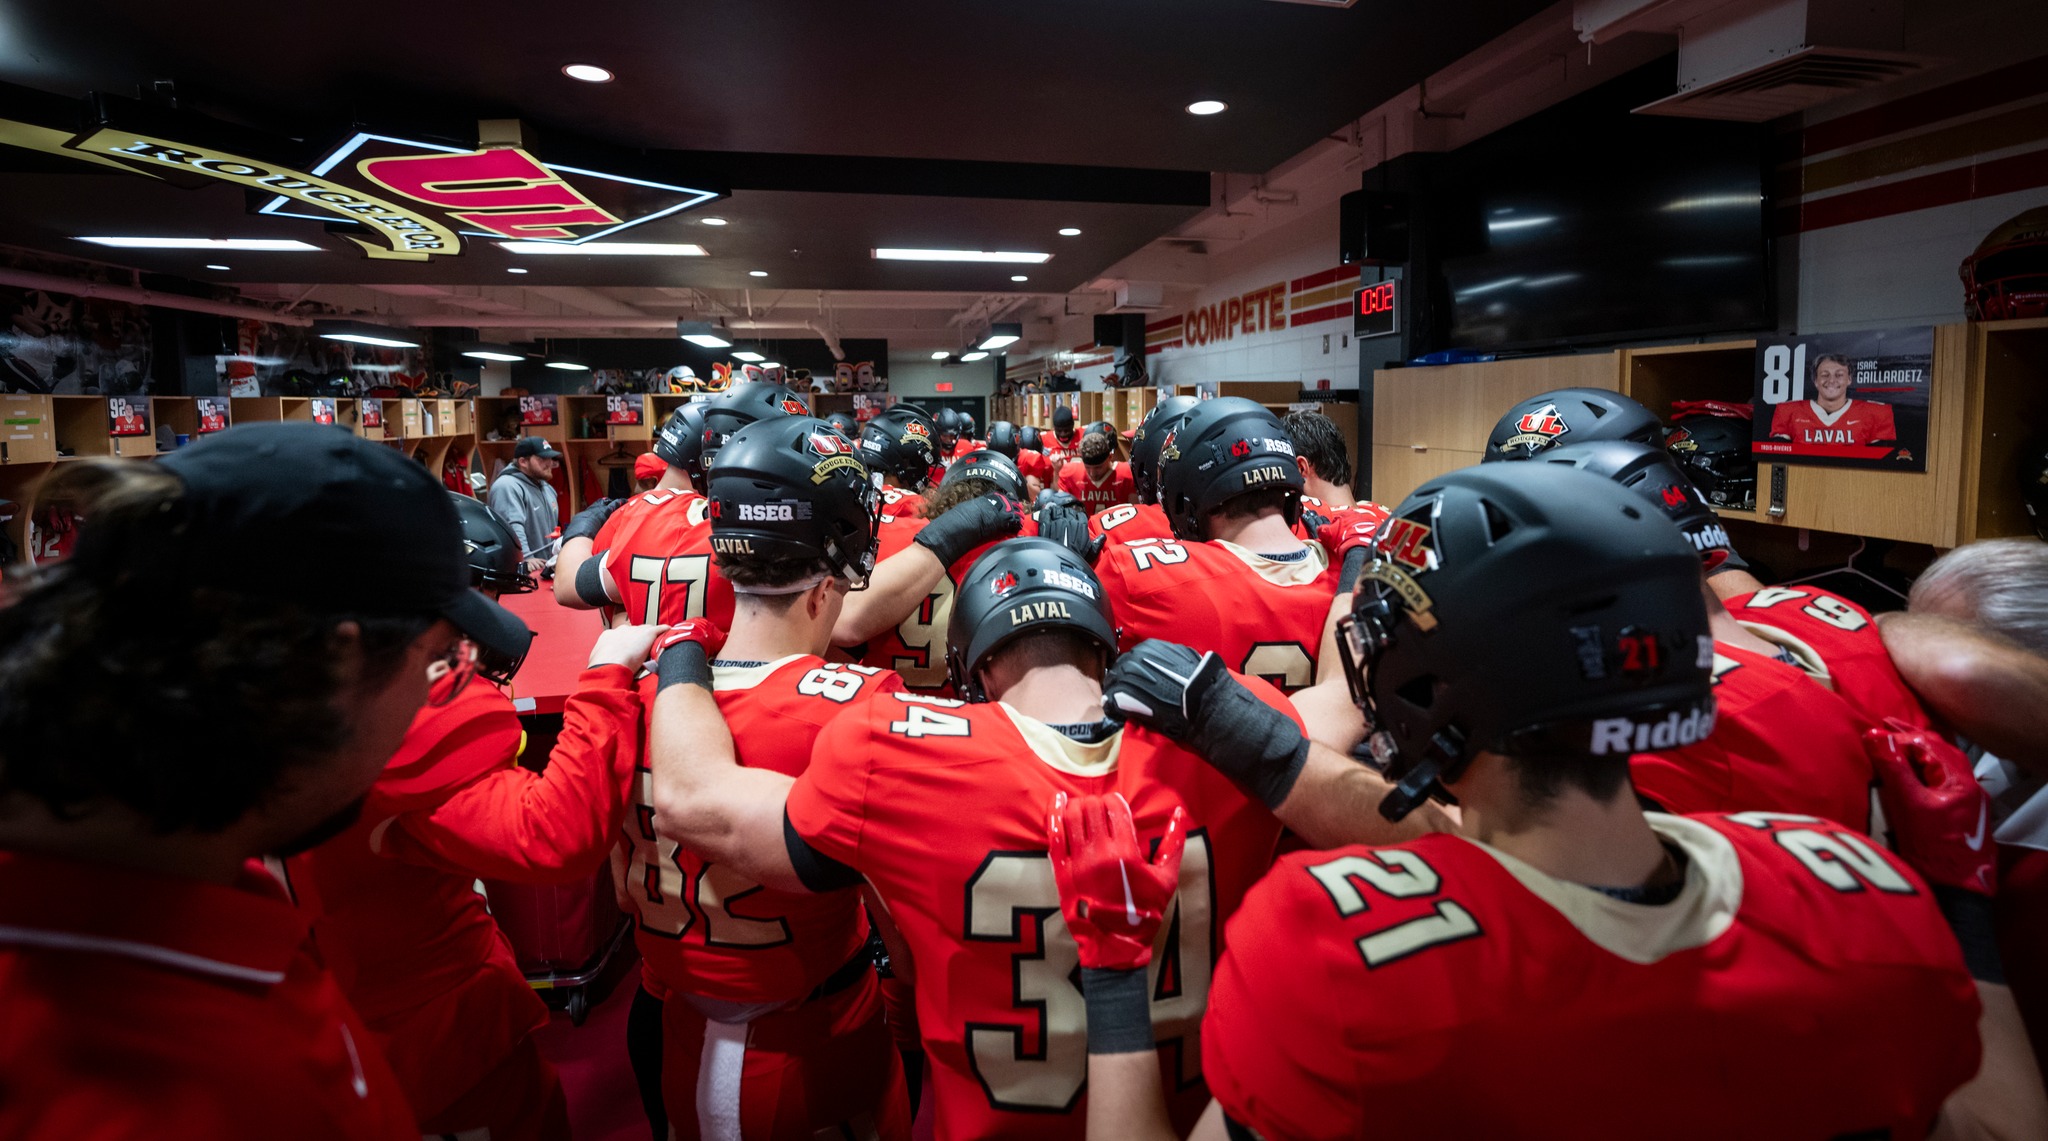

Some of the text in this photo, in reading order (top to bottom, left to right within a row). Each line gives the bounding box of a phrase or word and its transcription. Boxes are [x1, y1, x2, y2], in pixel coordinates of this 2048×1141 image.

[1185, 281, 1286, 348] COMPETE
[1762, 343, 1806, 405] 81
[1857, 360, 1878, 370] ISAAC
[1856, 369, 1922, 384] GAILLARDETZ
[110, 398, 126, 418] 92
[197, 399, 211, 417] 45
[520, 397, 535, 412] 53
[607, 396, 622, 412] 56
[853, 394, 867, 409] 98
[1519, 414, 1563, 435] UL
[808, 434, 854, 455] UL
[1804, 429, 1854, 444] LAVAL
[1231, 440, 1250, 457] 62
[819, 458, 844, 473] ROUGE
[966, 468, 998, 480] LAVAL
[1242, 466, 1287, 485] LAVAL
[1081, 490, 1117, 501] LAVAL
[1661, 485, 1688, 507] 64
[738, 504, 794, 521] RSEQ
[713, 538, 755, 554] LAVAL
[630, 553, 711, 626] 77
[1042, 568, 1096, 600] RSEQ
[1009, 601, 1071, 626] LAVAL
[1617, 633, 1661, 671] 21
[1306, 848, 1486, 971] 21
[962, 826, 1217, 1115] 34
